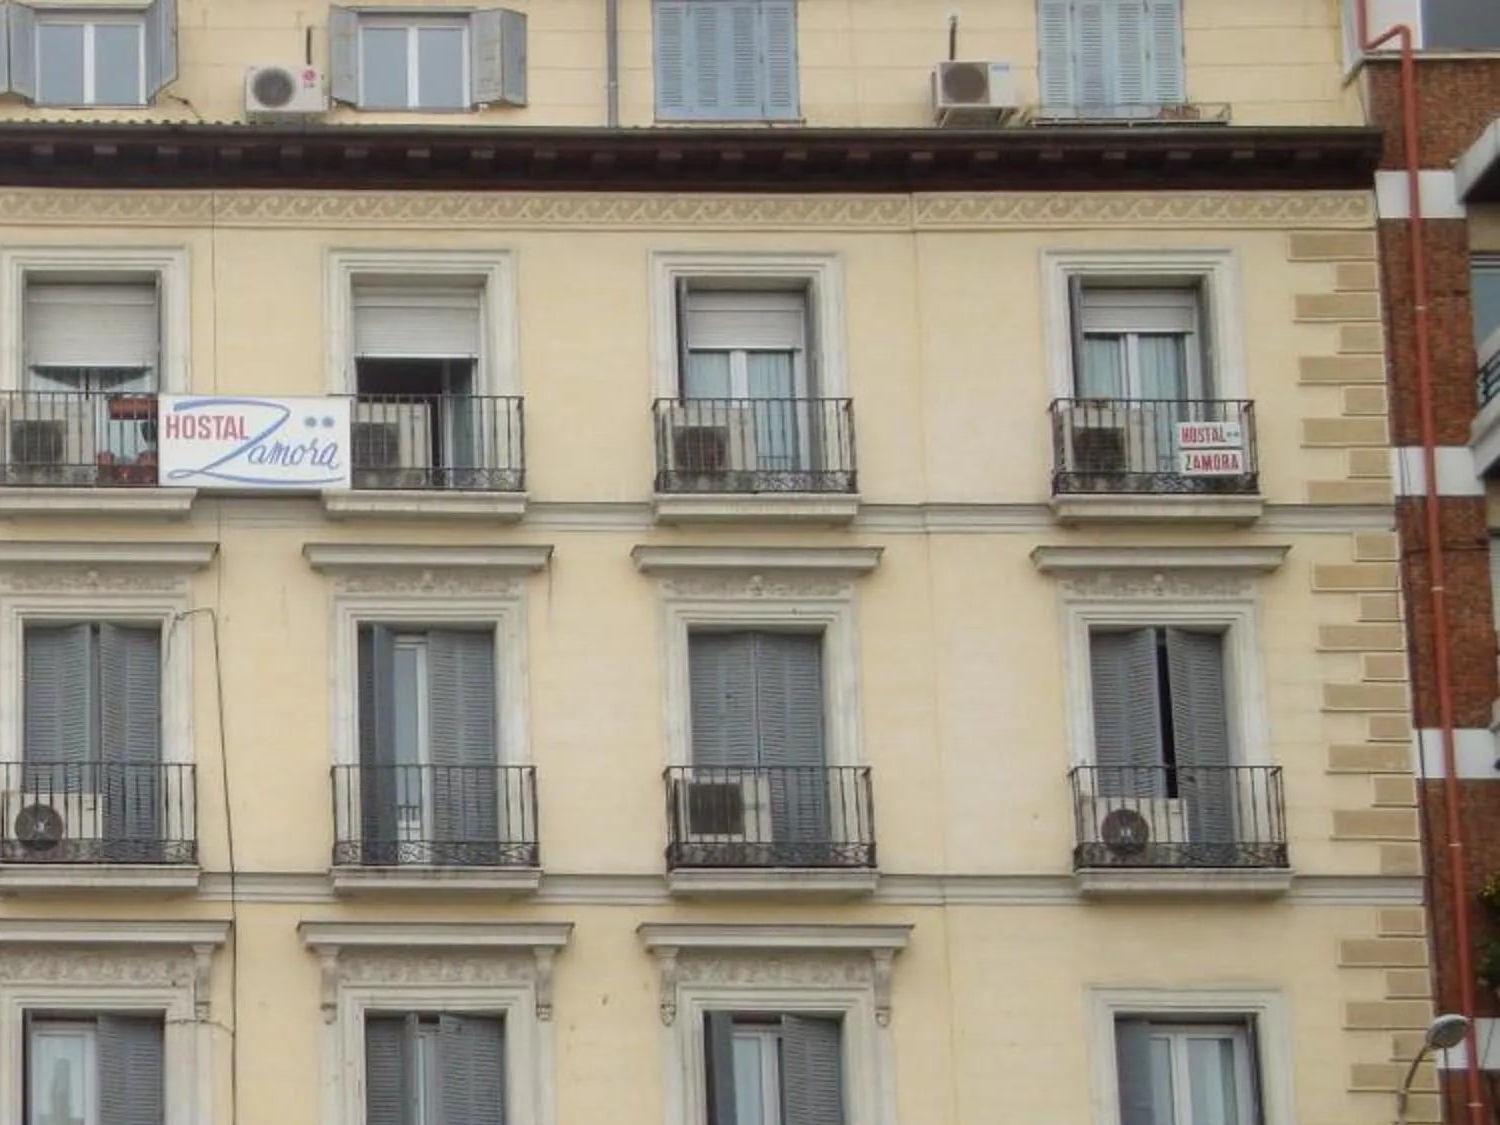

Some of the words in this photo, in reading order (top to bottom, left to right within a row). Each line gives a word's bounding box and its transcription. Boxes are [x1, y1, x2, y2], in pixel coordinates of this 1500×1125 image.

[165, 414, 250, 441] HOSTAL
[1181, 426, 1227, 443] HOSTAL
[167, 398, 345, 485] Zamora
[1185, 453, 1239, 471] ZAMORA
